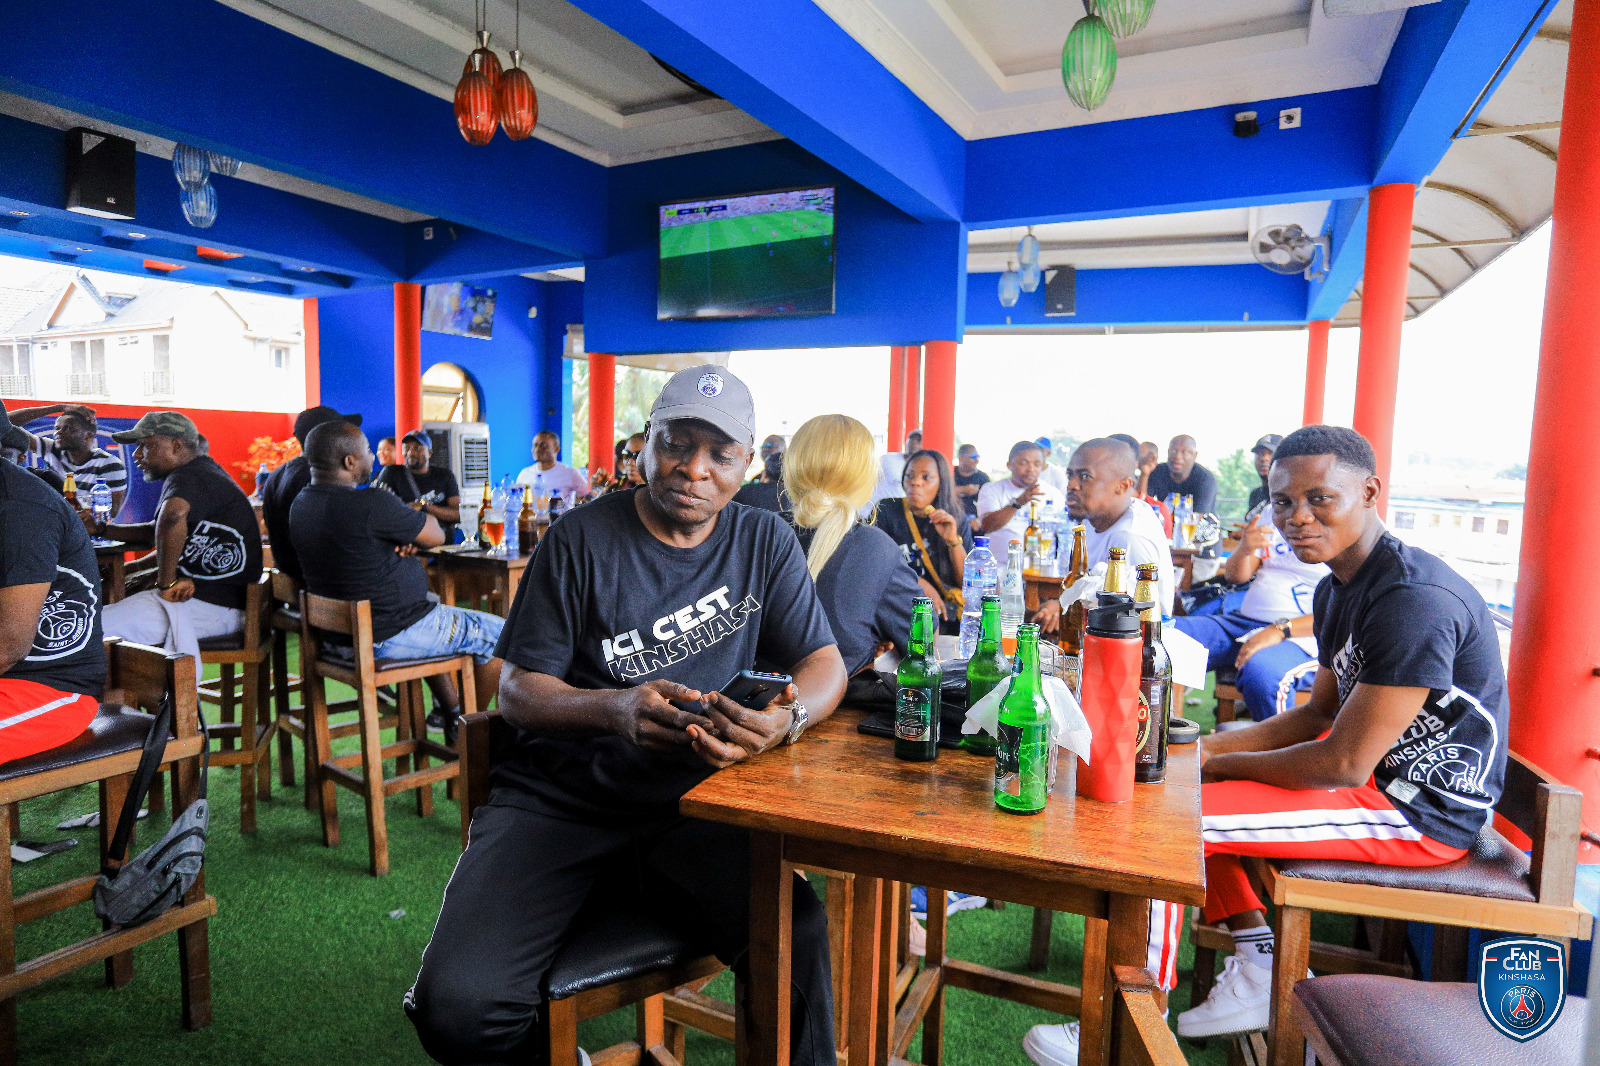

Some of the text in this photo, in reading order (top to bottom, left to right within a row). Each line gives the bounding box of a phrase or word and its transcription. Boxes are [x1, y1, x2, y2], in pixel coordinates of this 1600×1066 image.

[601, 585, 731, 662] ICI C'EST
[608, 593, 762, 682] KINSHASA
[1412, 747, 1460, 783] PARIS
[1255, 942, 1273, 954] 23
